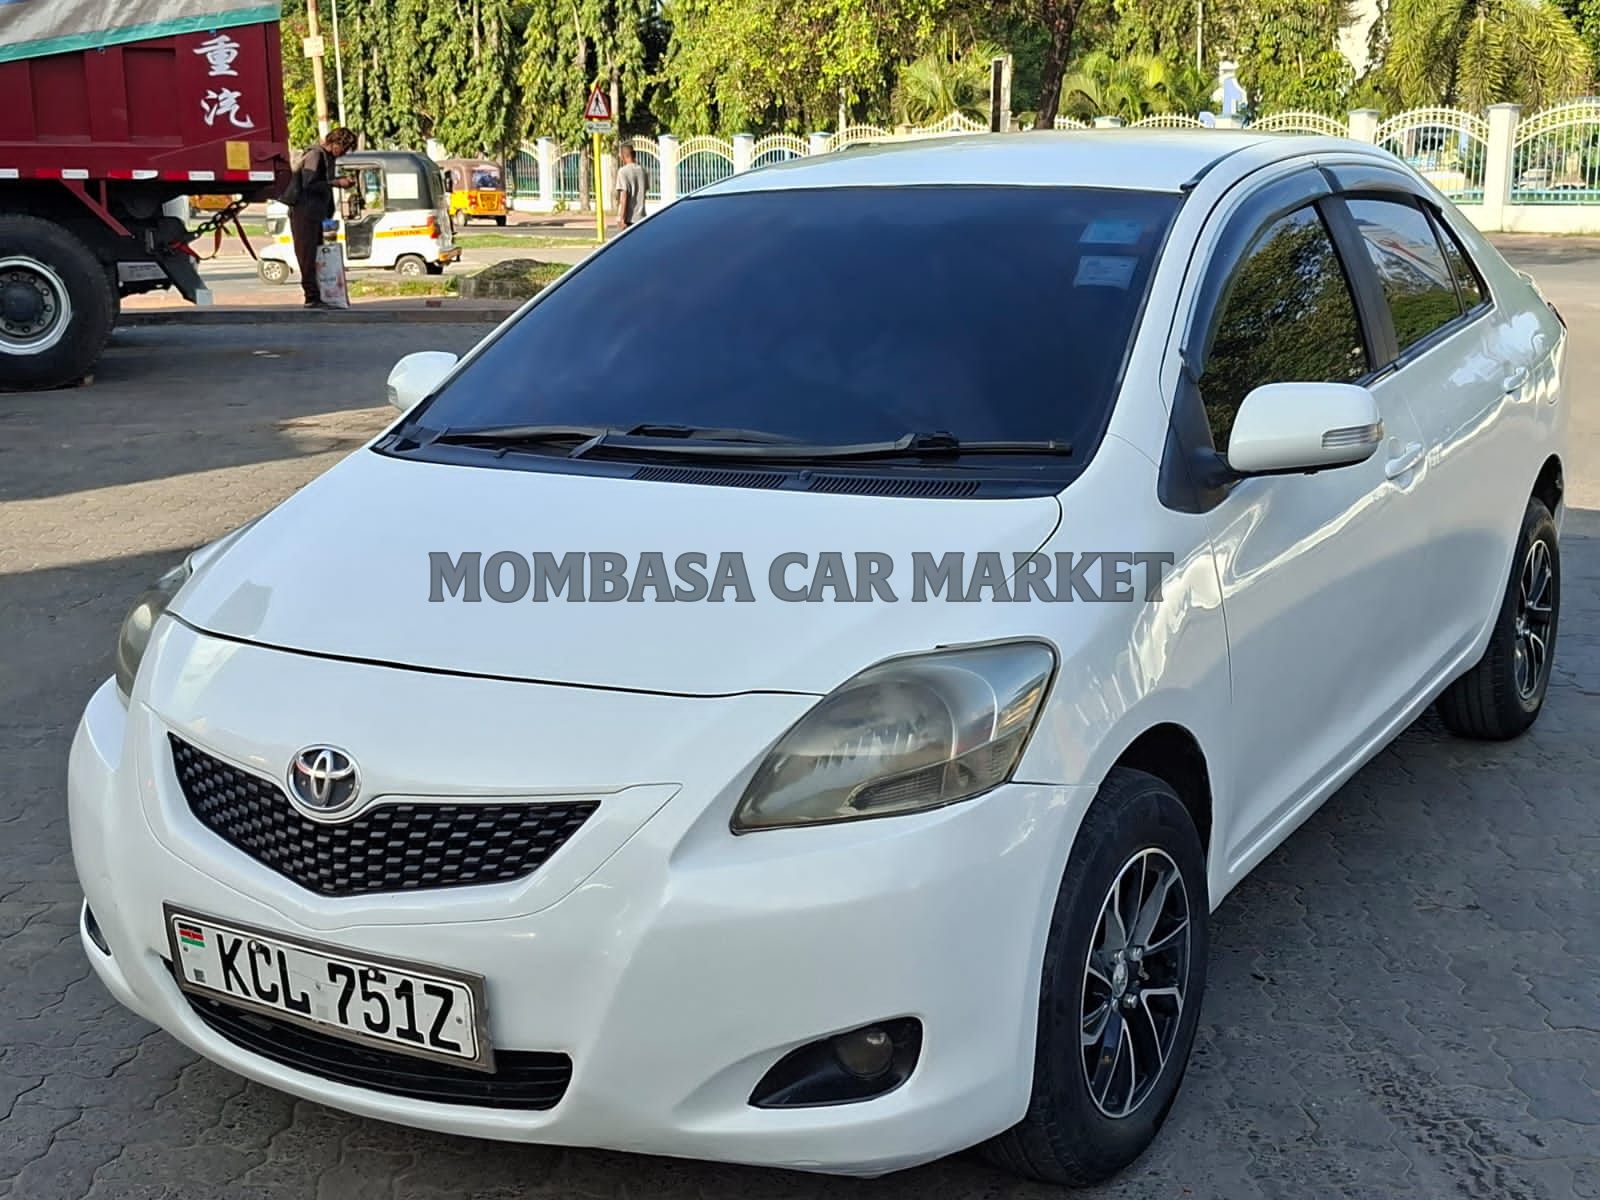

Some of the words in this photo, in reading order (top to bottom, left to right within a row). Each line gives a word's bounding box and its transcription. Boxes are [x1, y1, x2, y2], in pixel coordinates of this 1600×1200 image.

[193, 34, 254, 128] 重汽
[216, 933, 312, 1014] KCL
[327, 962, 462, 1053] 751Z
